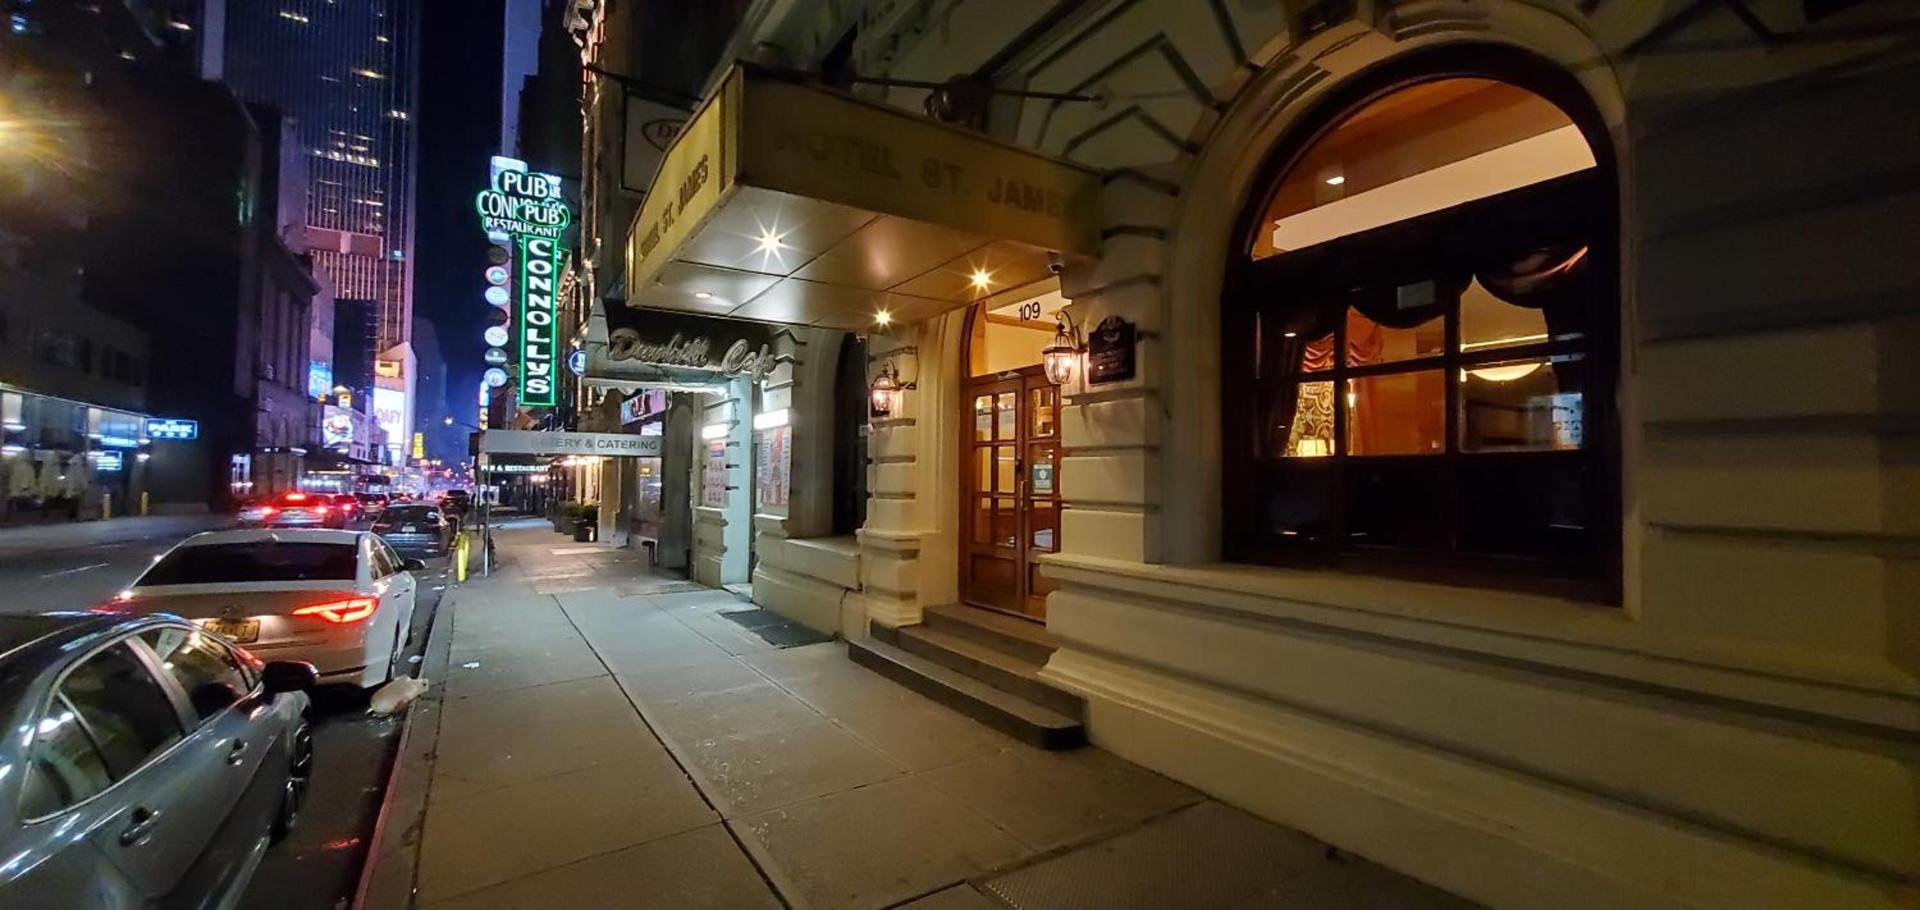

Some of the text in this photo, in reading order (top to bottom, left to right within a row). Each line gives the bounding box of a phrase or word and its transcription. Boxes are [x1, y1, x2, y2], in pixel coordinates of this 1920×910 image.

[503, 171, 549, 198] PUB
[679, 154, 709, 215] JAMES
[525, 204, 561, 225] PUB
[485, 217, 559, 238] RESTAURANT
[1018, 301, 1041, 322] 109
[148, 423, 193, 433] PARK
[597, 440, 658, 451] CATERING
